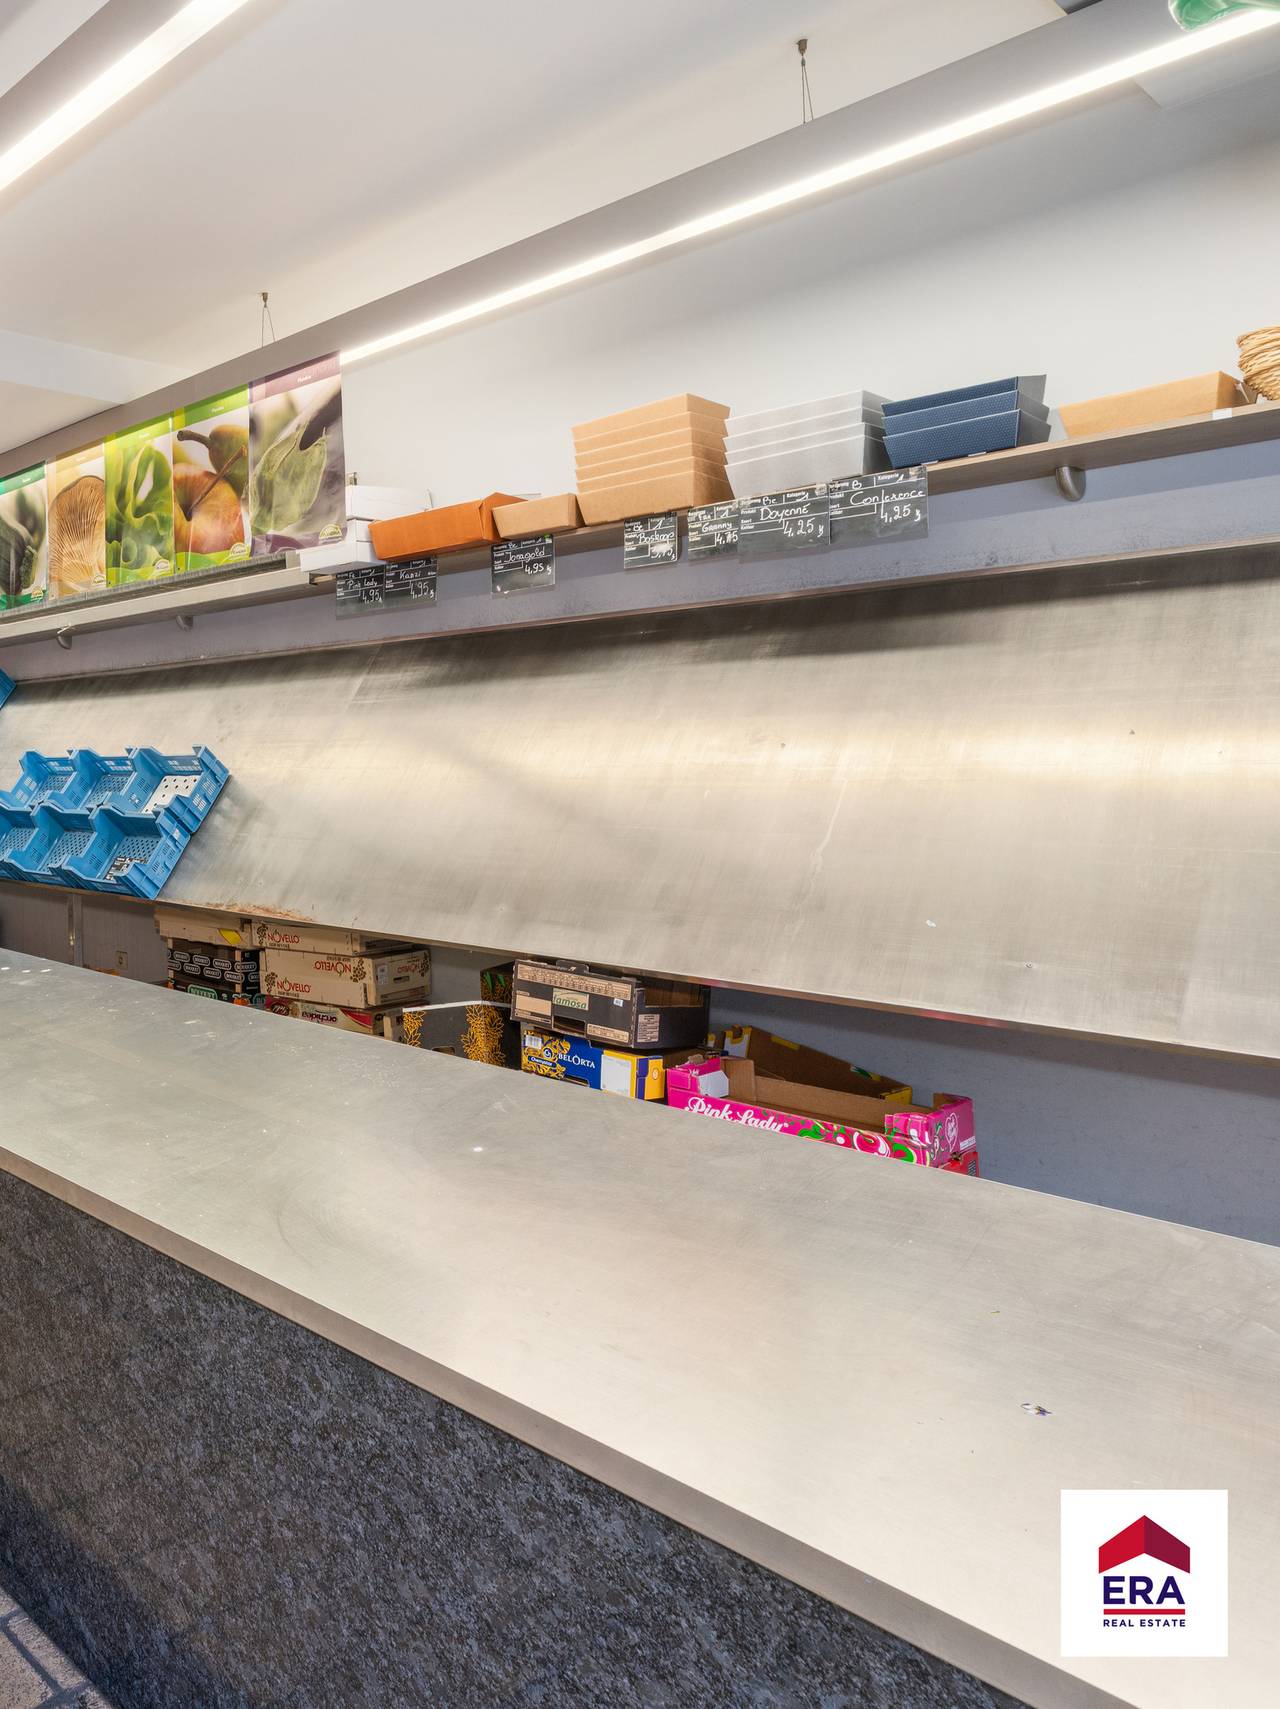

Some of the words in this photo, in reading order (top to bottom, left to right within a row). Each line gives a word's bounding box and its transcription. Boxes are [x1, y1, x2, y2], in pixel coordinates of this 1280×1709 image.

[267, 930, 300, 944] NOVELLO
[314, 961, 352, 976] NOVELLO
[277, 978, 311, 994] NOVELLO
[684, 1097, 733, 1122] Pink
[735, 1109, 784, 1133] Lady
